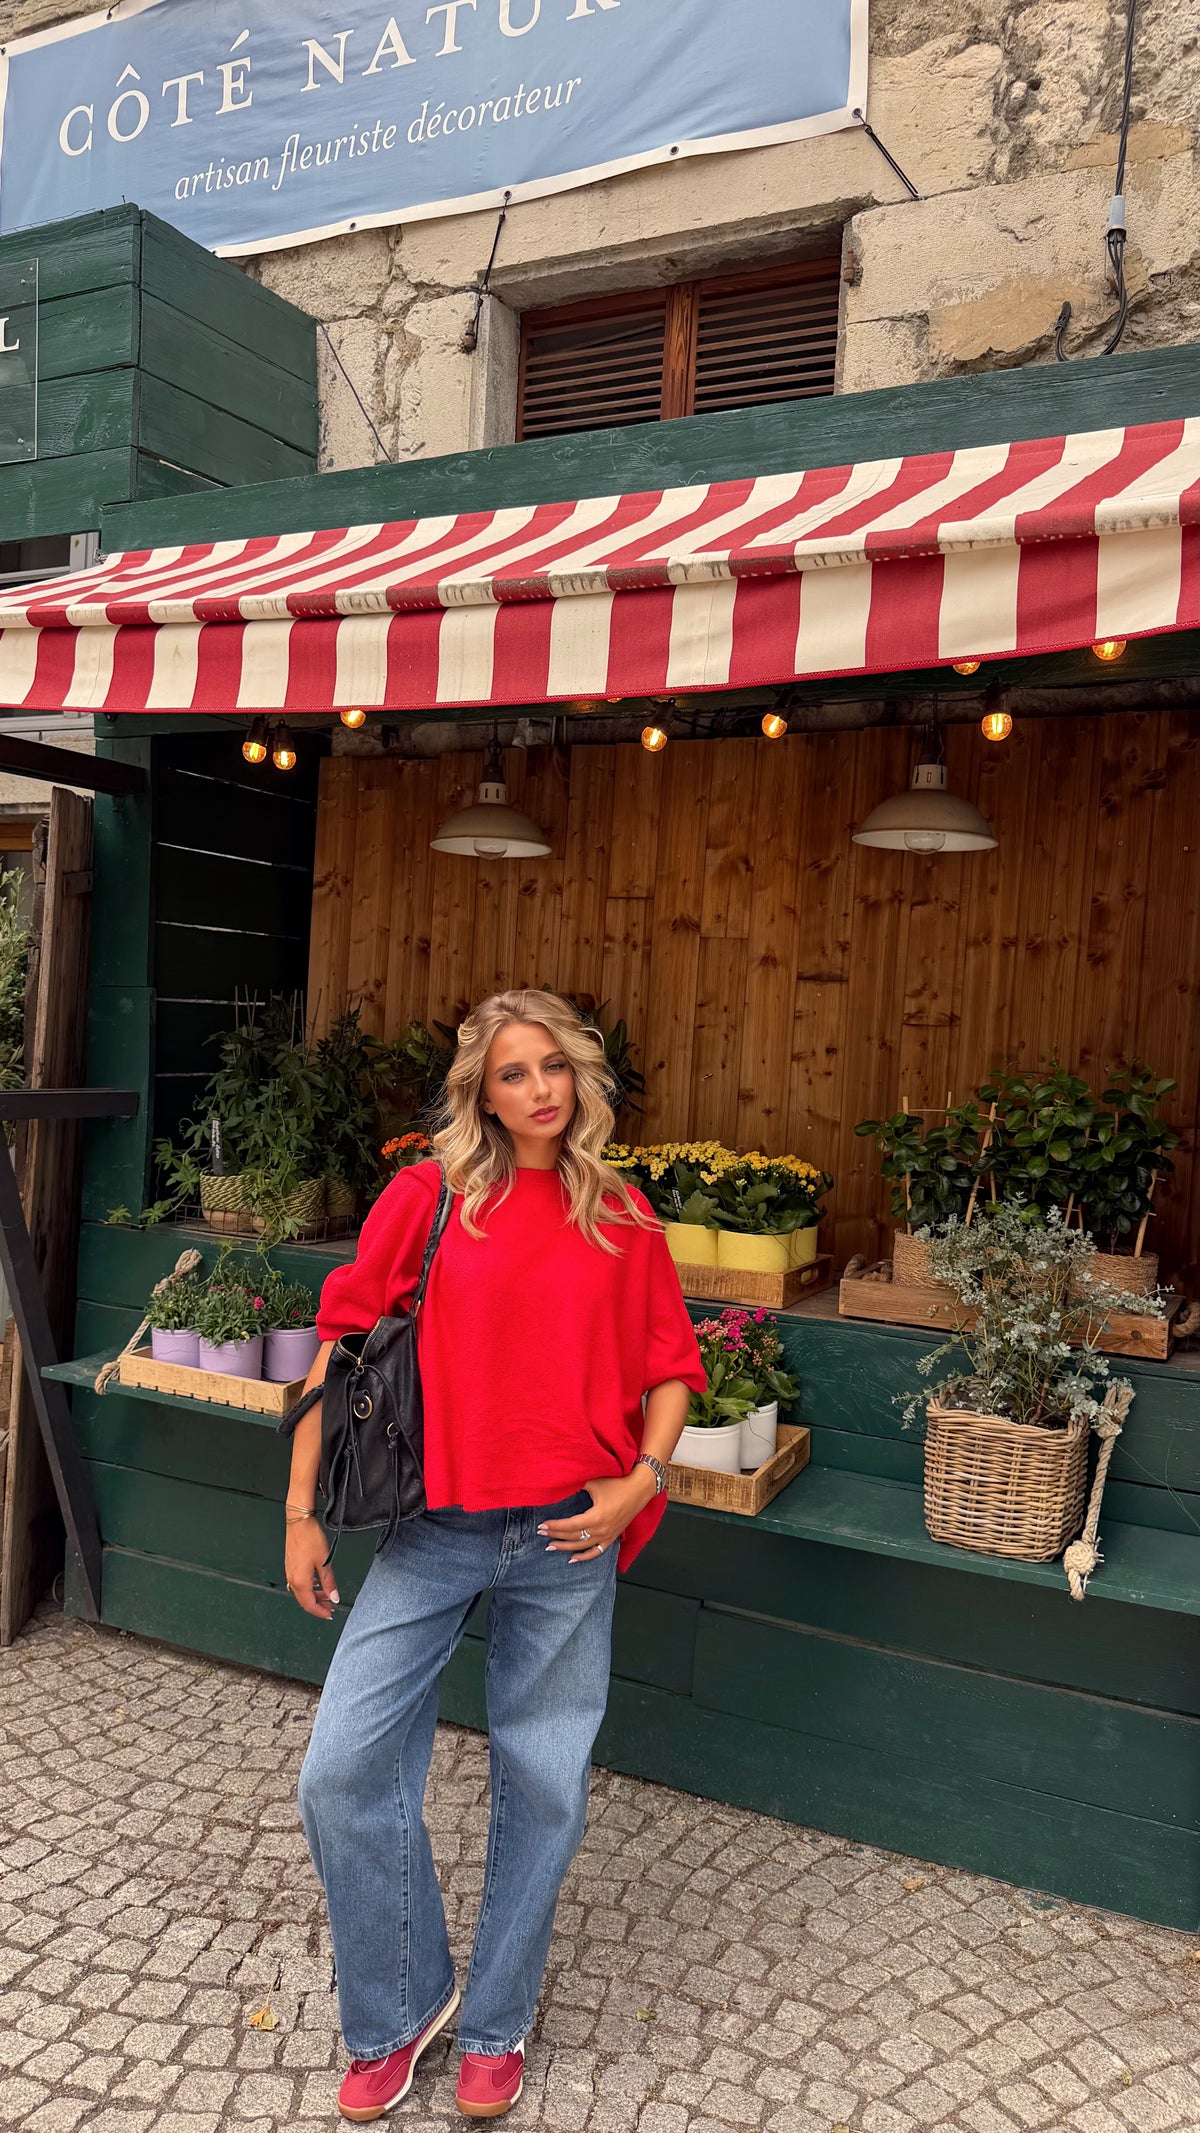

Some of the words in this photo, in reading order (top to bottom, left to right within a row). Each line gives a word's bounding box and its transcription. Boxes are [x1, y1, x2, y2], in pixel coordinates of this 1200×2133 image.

[59, 29, 253, 156] CÔTÉ
[174, 157, 270, 200] artisan
[271, 119, 397, 191] fleuriste
[407, 77, 582, 144] décorateur
